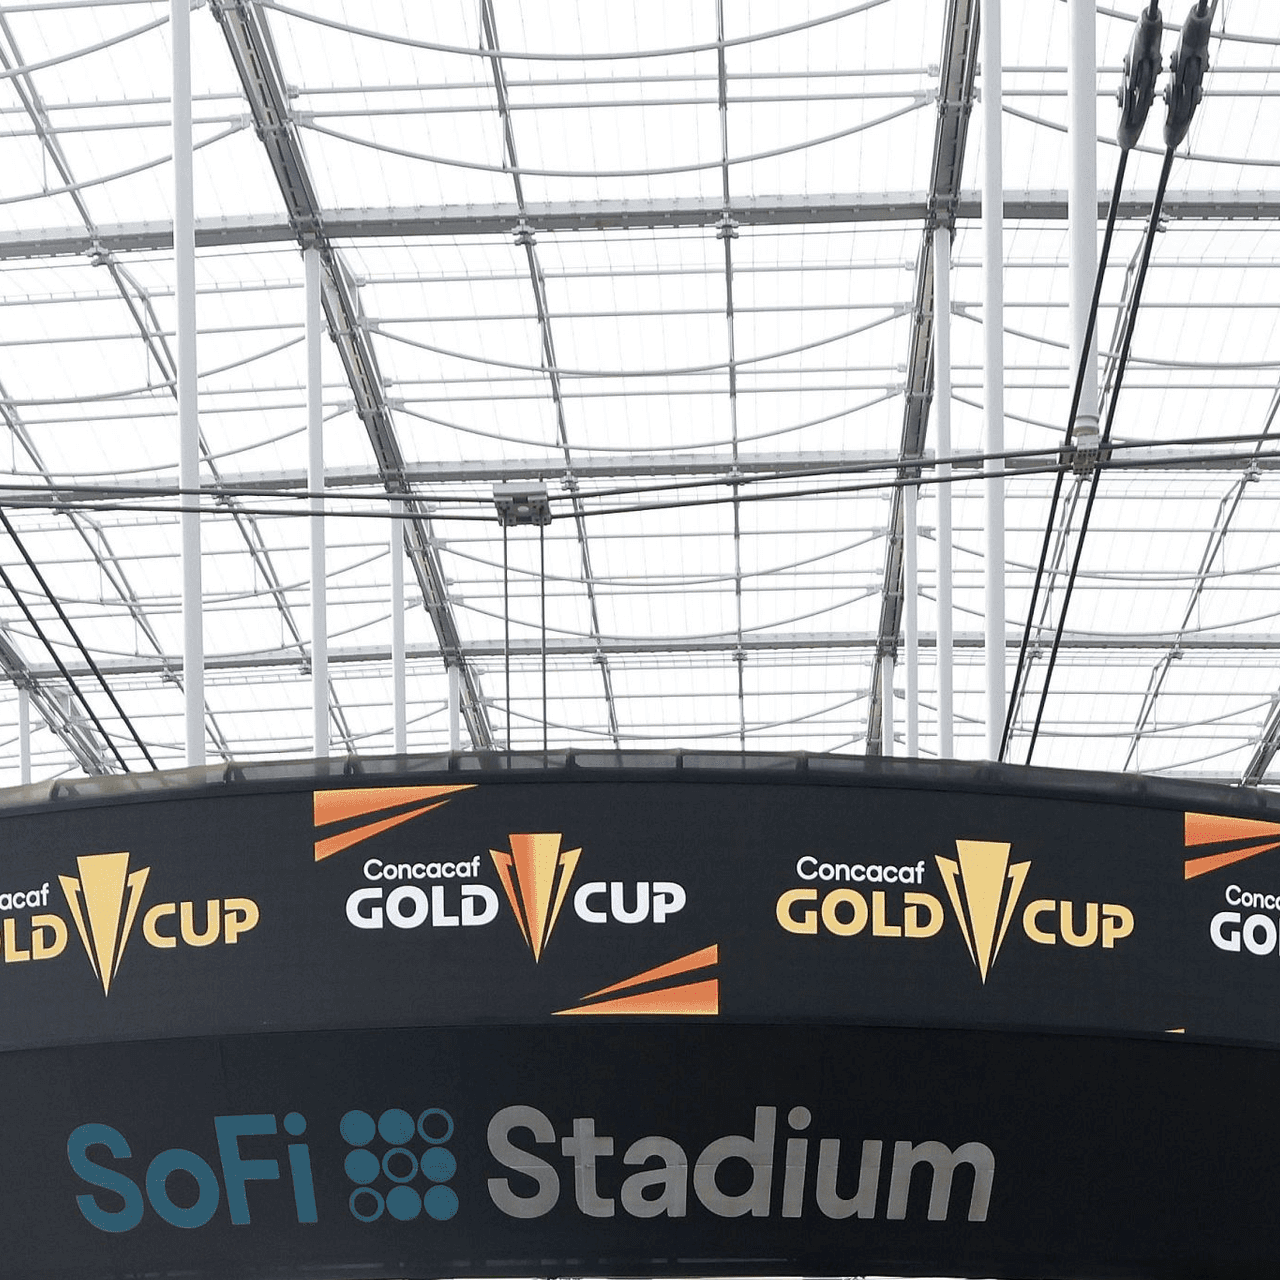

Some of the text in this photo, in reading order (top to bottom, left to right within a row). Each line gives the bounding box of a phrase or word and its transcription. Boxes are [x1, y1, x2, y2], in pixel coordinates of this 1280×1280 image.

[363, 855, 481, 881] Concacaf
[796, 855, 925, 885] Concacaf
[142, 895, 260, 949] CUP
[345, 880, 686, 929] GOLD CUP
[775, 888, 1134, 949] GOLD CUP
[66, 1104, 994, 1233] SoFi Stadium
